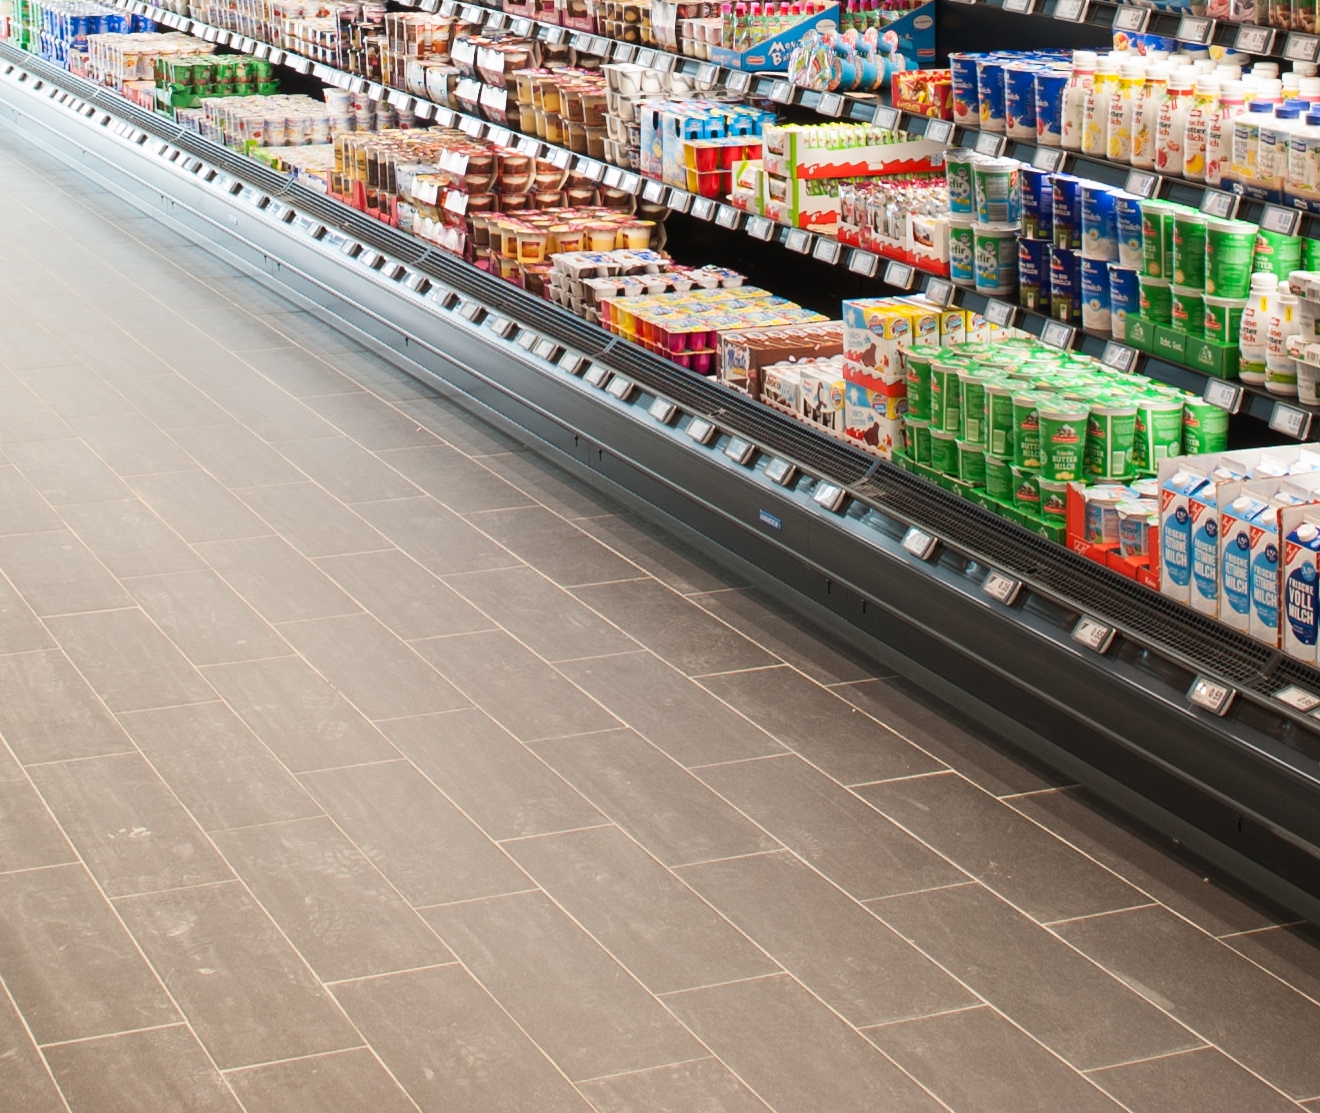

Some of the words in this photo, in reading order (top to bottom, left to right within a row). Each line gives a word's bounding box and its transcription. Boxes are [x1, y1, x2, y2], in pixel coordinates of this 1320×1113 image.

[1052, 455, 1078, 464] BUTTER
[1054, 462, 1076, 471] MILCH
[1165, 547, 1188, 566] MILCH
[1194, 561, 1216, 580] MILCH
[1225, 575, 1248, 594] MILCH
[1289, 577, 1314, 596] FRISCHE
[1254, 587, 1277, 607] MILCH
[1288, 588, 1314, 611] VOLL
[1288, 605, 1314, 626] MILCH
